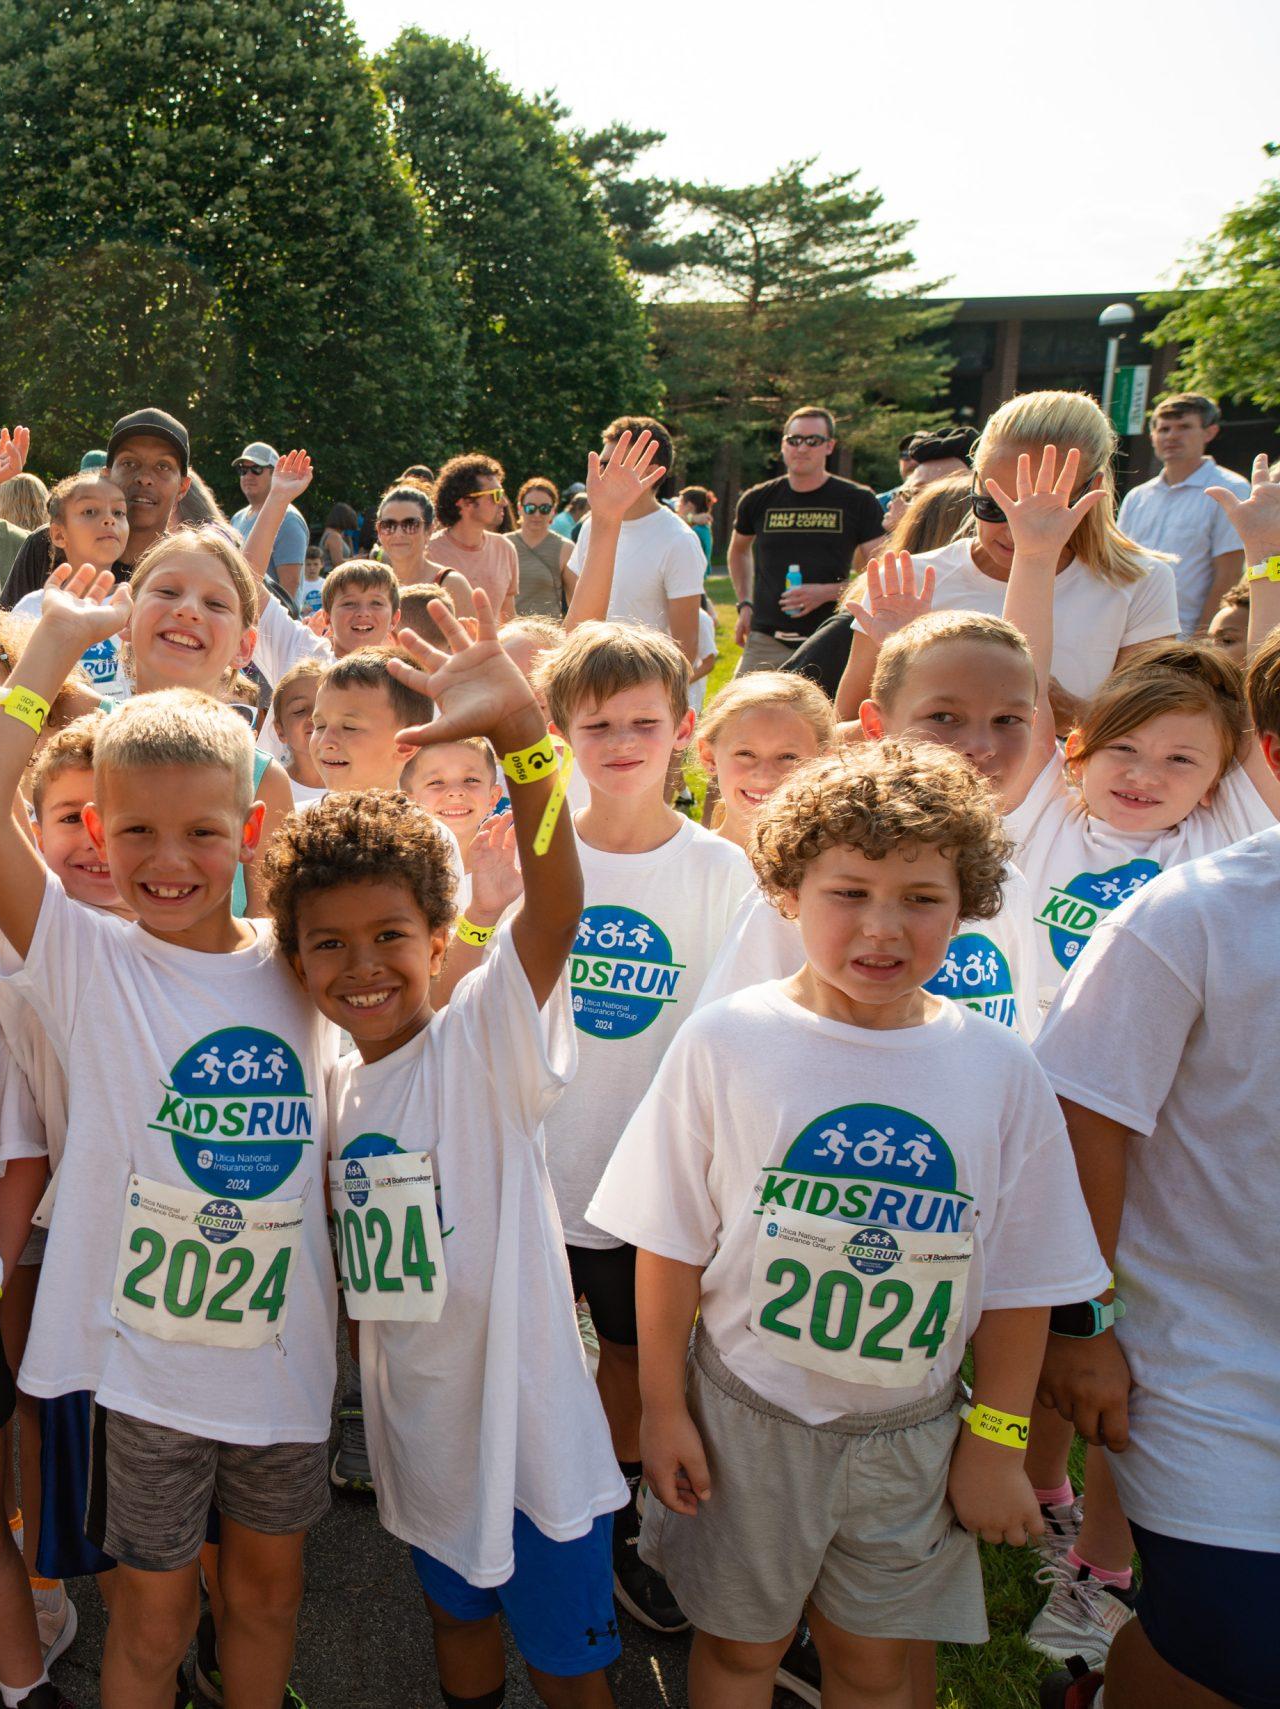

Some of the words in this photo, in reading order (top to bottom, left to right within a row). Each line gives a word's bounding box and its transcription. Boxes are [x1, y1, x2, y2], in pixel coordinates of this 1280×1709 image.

[769, 520, 795, 528] HALF
[796, 520, 837, 529] COFFEE
[770, 512, 795, 521] HALF
[797, 513, 837, 521] HUMAN
[511, 756, 528, 781] 0956
[1041, 895, 1100, 931] KID
[570, 958, 681, 996] DSRUN
[583, 1005, 616, 1017] Insurance
[617, 1009, 638, 1021] Group
[602, 1001, 631, 1012] National
[595, 1019, 613, 1031] 2024
[156, 1092, 312, 1137] KIDSRUN
[215, 1152, 235, 1163] Utica
[237, 1152, 271, 1163] National
[213, 1162, 254, 1172] Insurance
[256, 1162, 280, 1173] Group
[225, 1178, 251, 1191] 2024
[392, 1174, 432, 1185] Boilermaker
[760, 1174, 968, 1233] KIDSRUN
[194, 1214, 247, 1230] KIDSRUN
[778, 1233, 811, 1247] Insurance
[812, 1241, 835, 1252] Group
[780, 1226, 797, 1237] Utica
[798, 1231, 827, 1244] National
[842, 1244, 903, 1262] KIDSRUN
[932, 1252, 972, 1262] Boilermaker
[123, 1226, 292, 1323] 2024
[760, 1257, 954, 1363] 2024
[981, 1412, 1003, 1426] KIDS
[979, 1421, 1000, 1434] RUN
